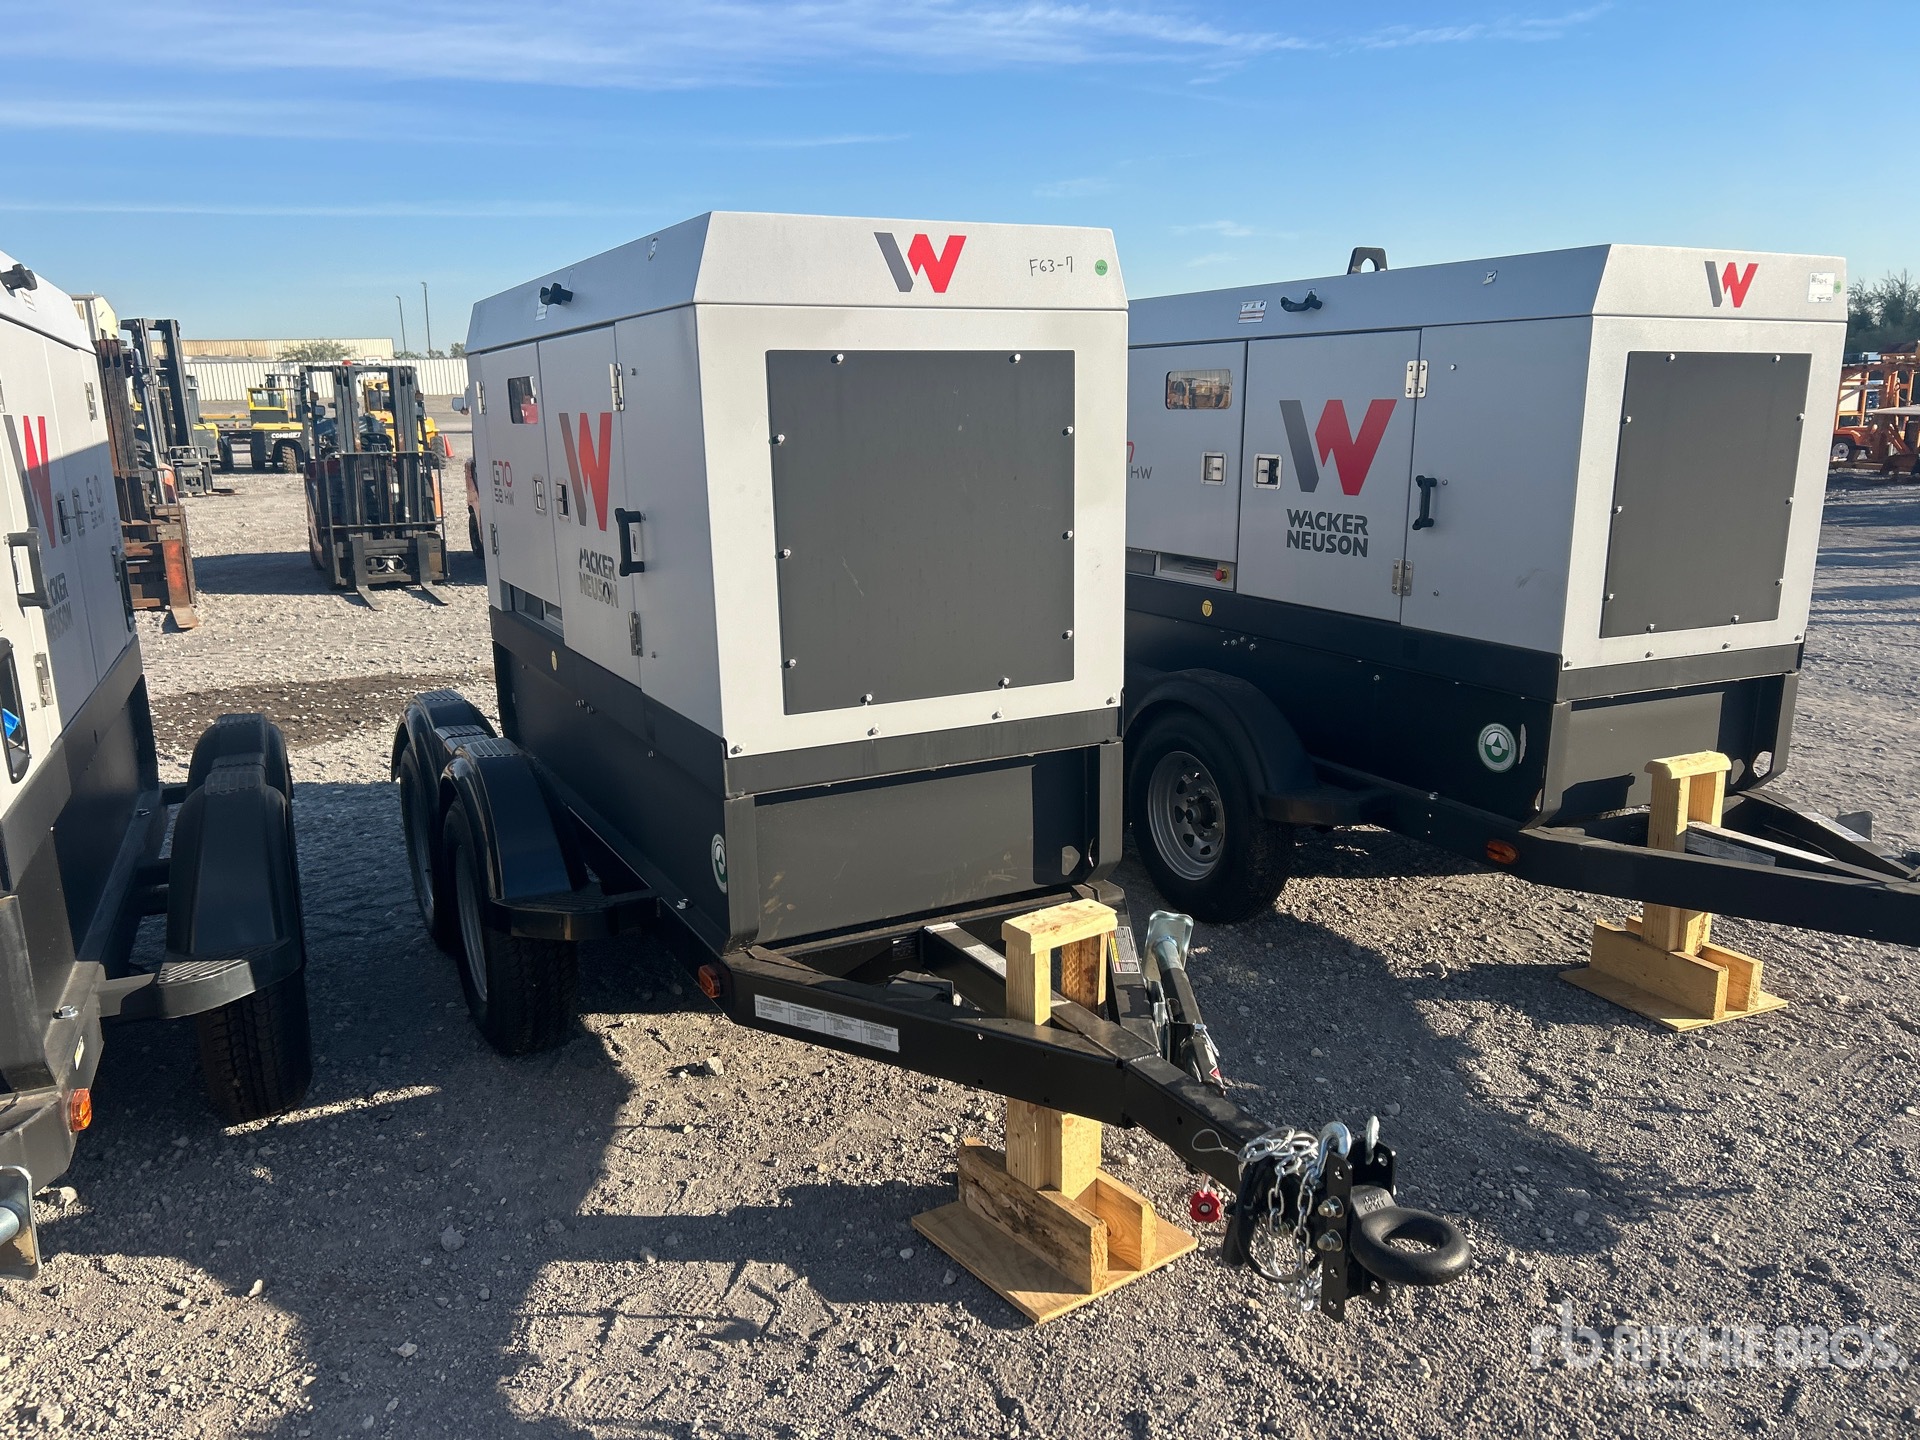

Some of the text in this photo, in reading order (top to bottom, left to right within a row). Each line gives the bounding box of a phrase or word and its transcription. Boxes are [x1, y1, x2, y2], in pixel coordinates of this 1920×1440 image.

[1029, 255, 1073, 277] F63-7
[1286, 508, 1369, 536] WACKER
[1286, 530, 1369, 558] NEUSON
[578, 571, 619, 608] NEUSON
